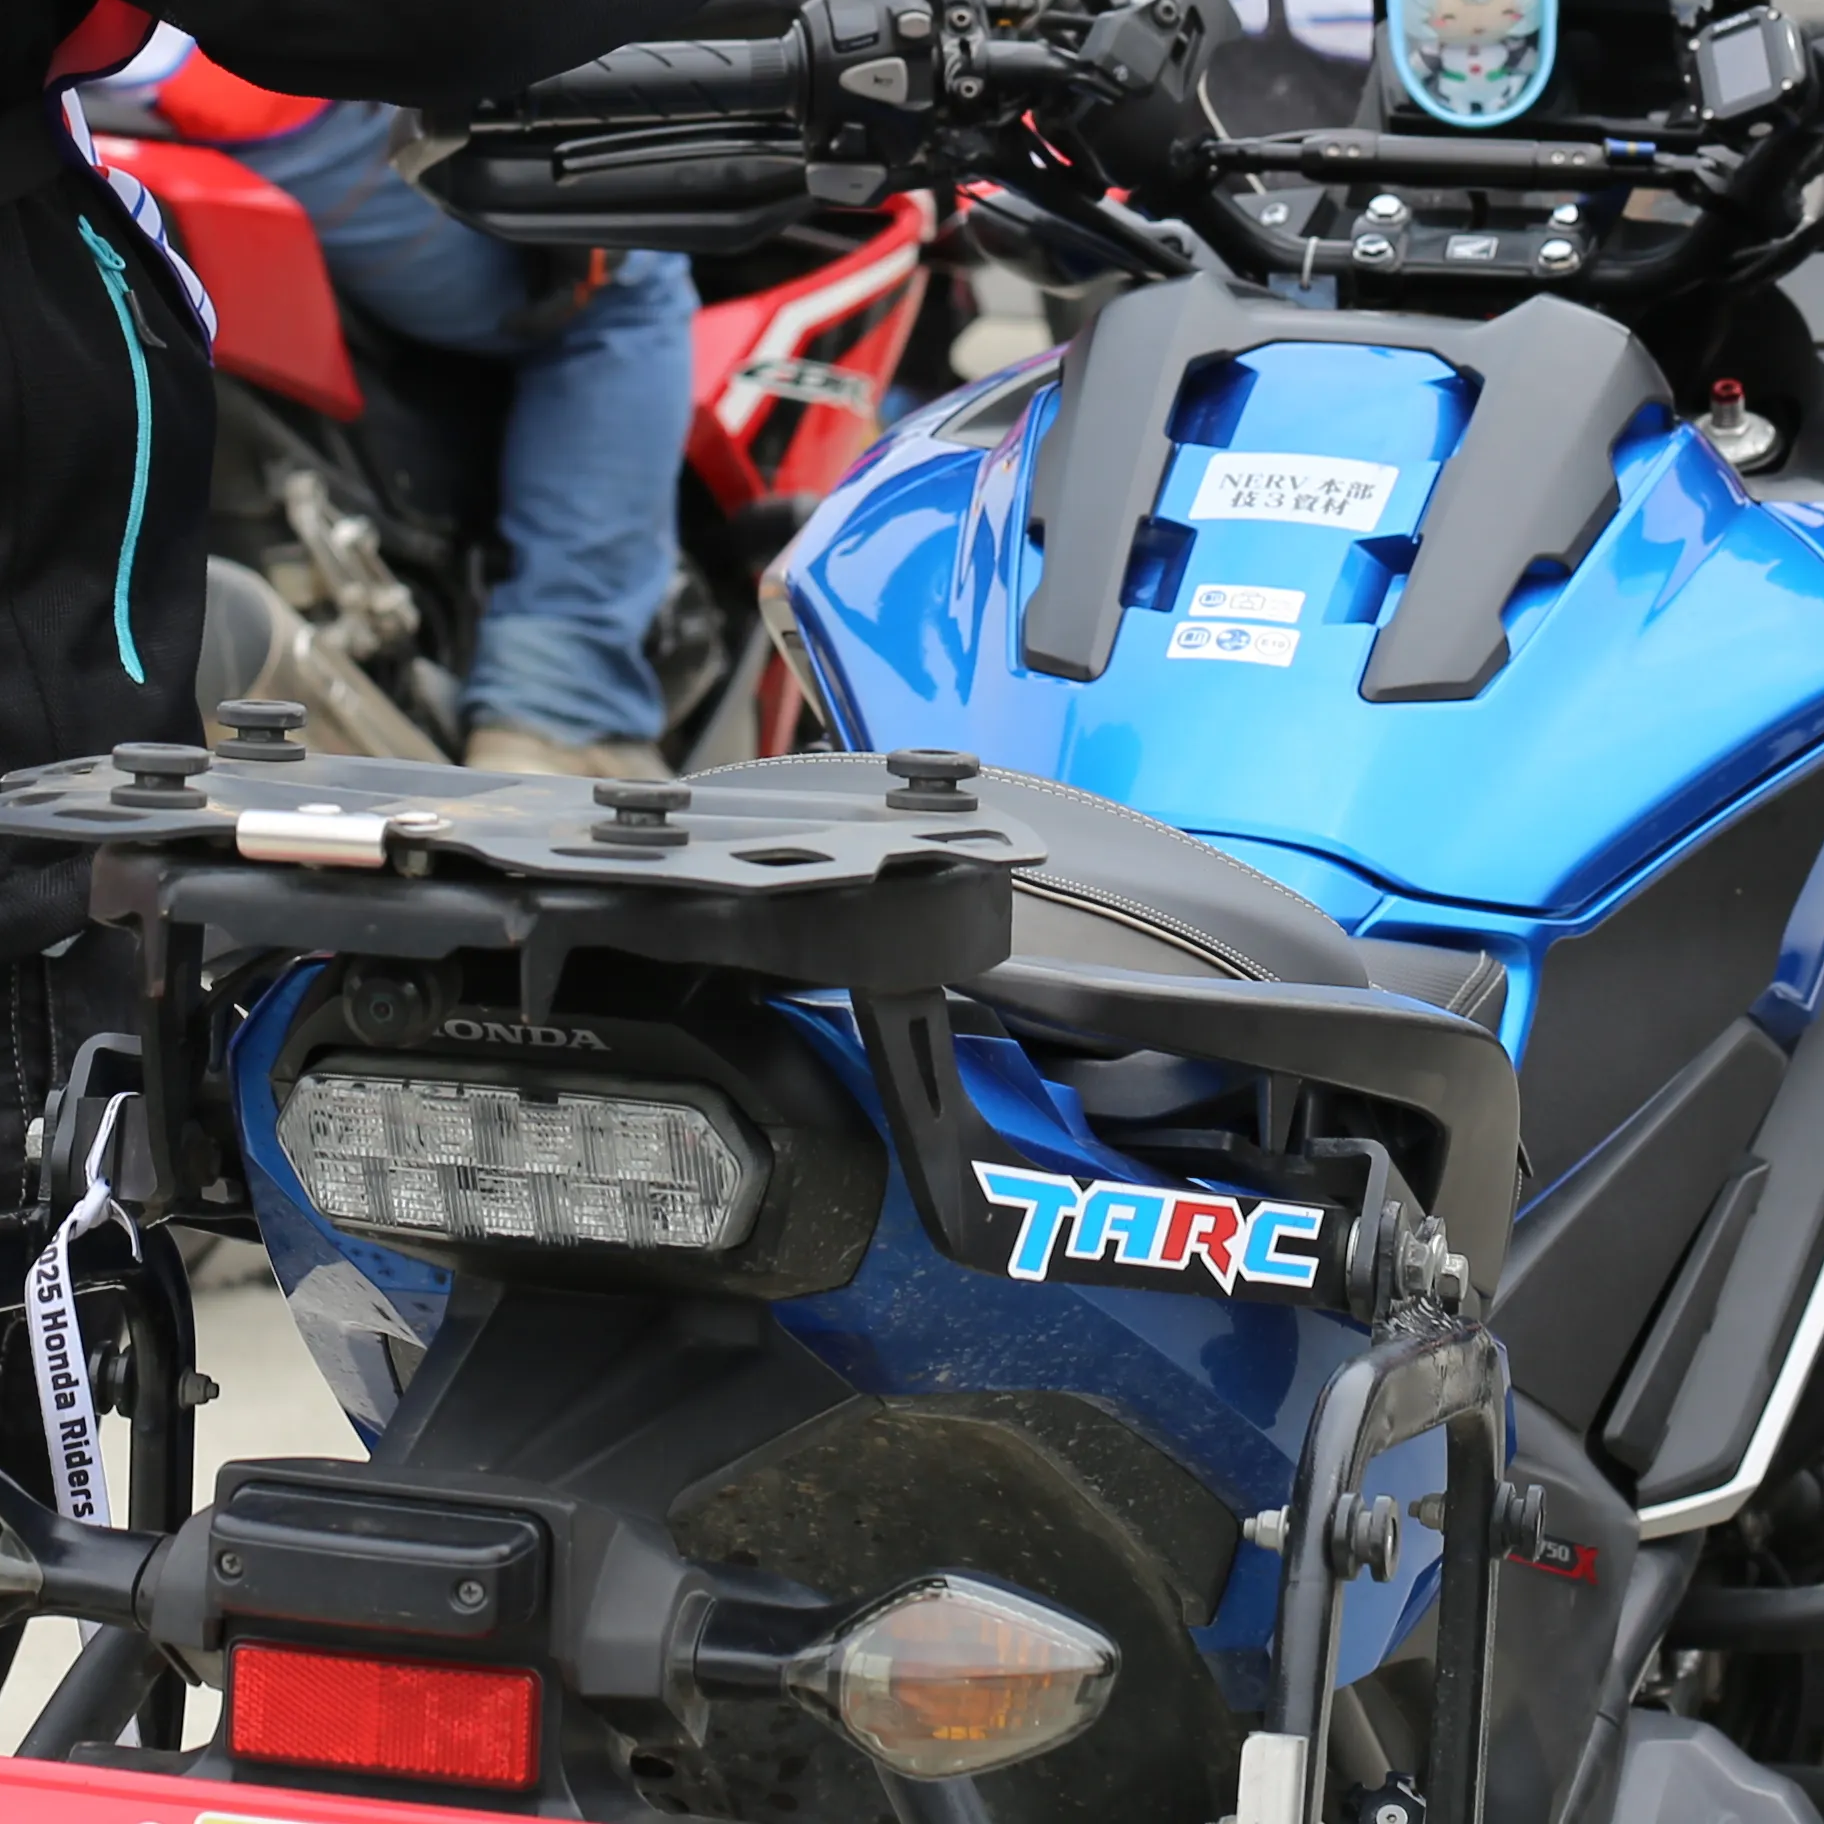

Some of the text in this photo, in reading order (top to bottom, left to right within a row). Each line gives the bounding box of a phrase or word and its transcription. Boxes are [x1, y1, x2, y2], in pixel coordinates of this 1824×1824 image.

[1219, 473, 1376, 500] NERV 本部
[432, 1019, 612, 1051] ONDA
[970, 1160, 1325, 1296] TARC
[41, 1308, 79, 1411] Honda
[59, 1416, 94, 1518] Riders
